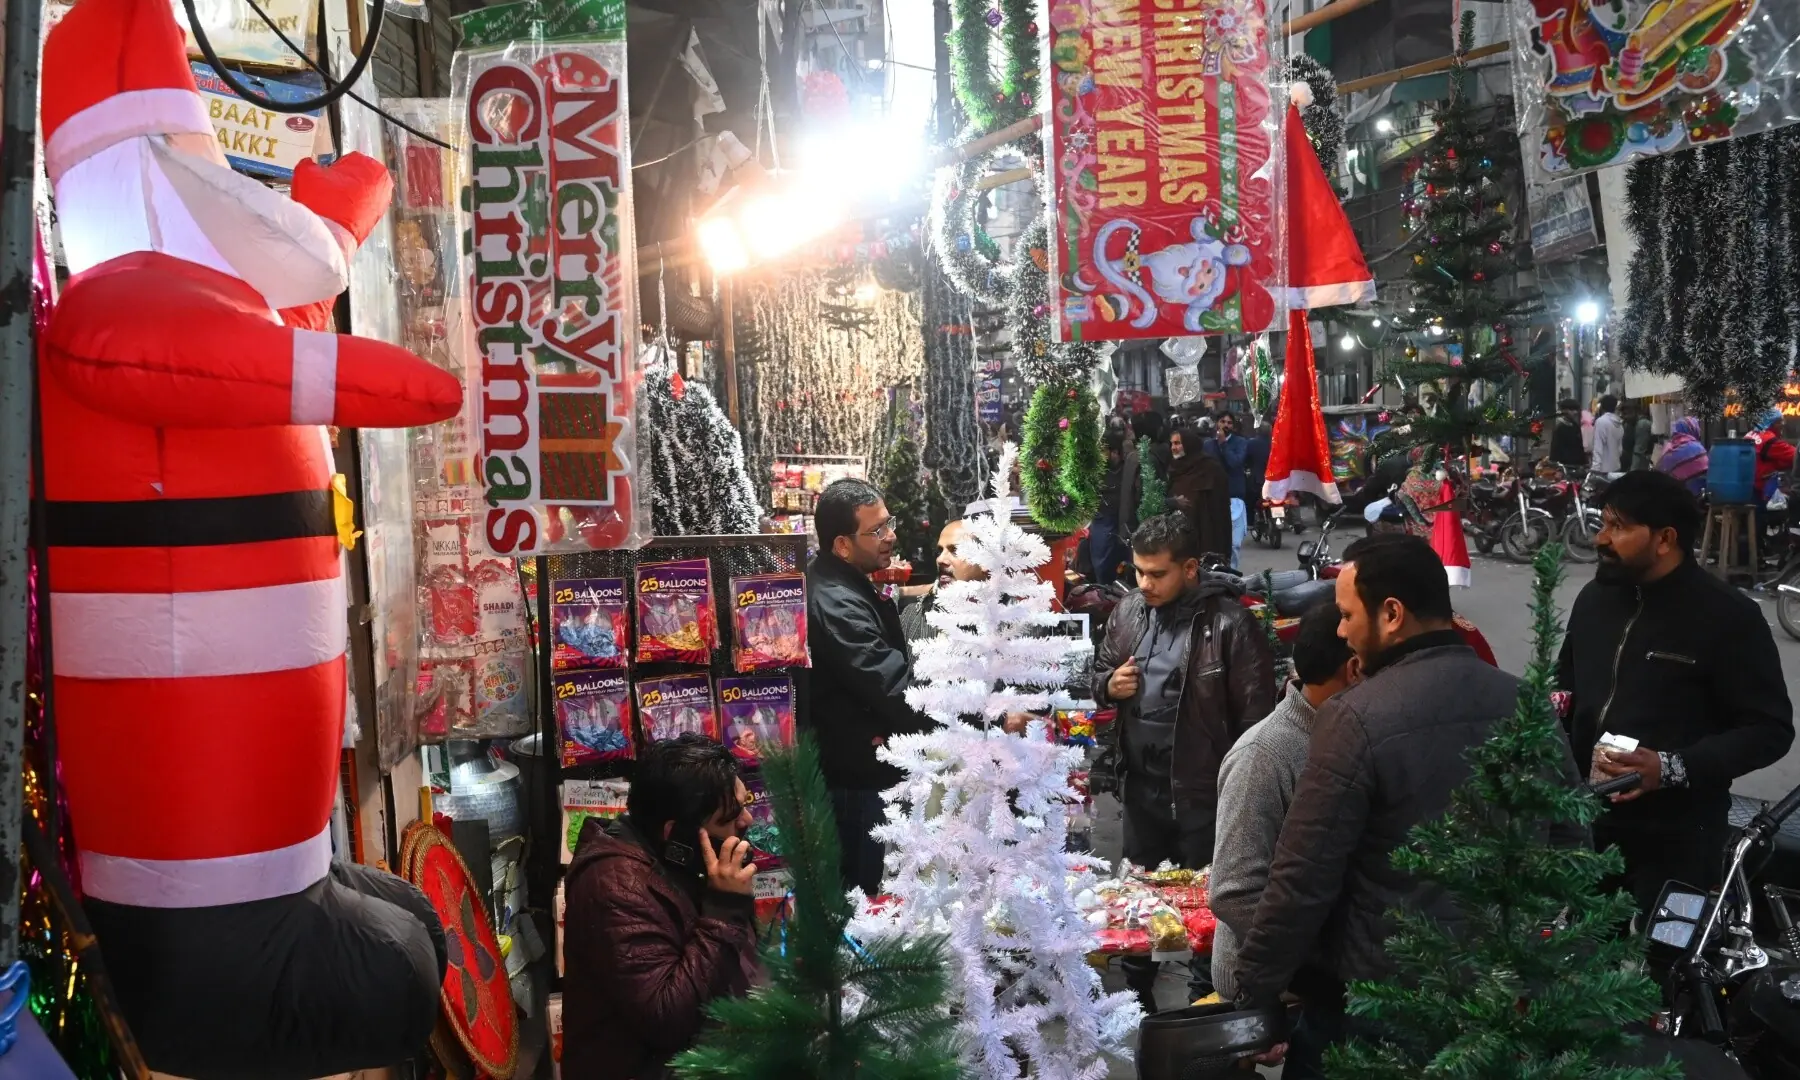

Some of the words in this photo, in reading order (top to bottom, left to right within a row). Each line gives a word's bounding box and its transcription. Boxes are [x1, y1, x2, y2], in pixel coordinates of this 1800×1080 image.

[210, 98, 276, 130] BAAT
[1096, 101, 1147, 209] YEAR
[542, 74, 619, 379] Merry
[469, 65, 548, 553] Christmas
[640, 577, 659, 592] 25
[659, 579, 707, 588] BALLOONS
[555, 588, 574, 603] 25
[738, 590, 756, 606] 25
[756, 588, 803, 601] BALLOONS
[483, 602, 514, 611] SHAADI
[557, 681, 576, 698] 25
[576, 677, 625, 692] BALLOONS
[643, 690, 662, 707] 25
[661, 686, 709, 700] BALLOONS
[723, 687, 741, 702] 50
[742, 686, 788, 697] BALLOONS
